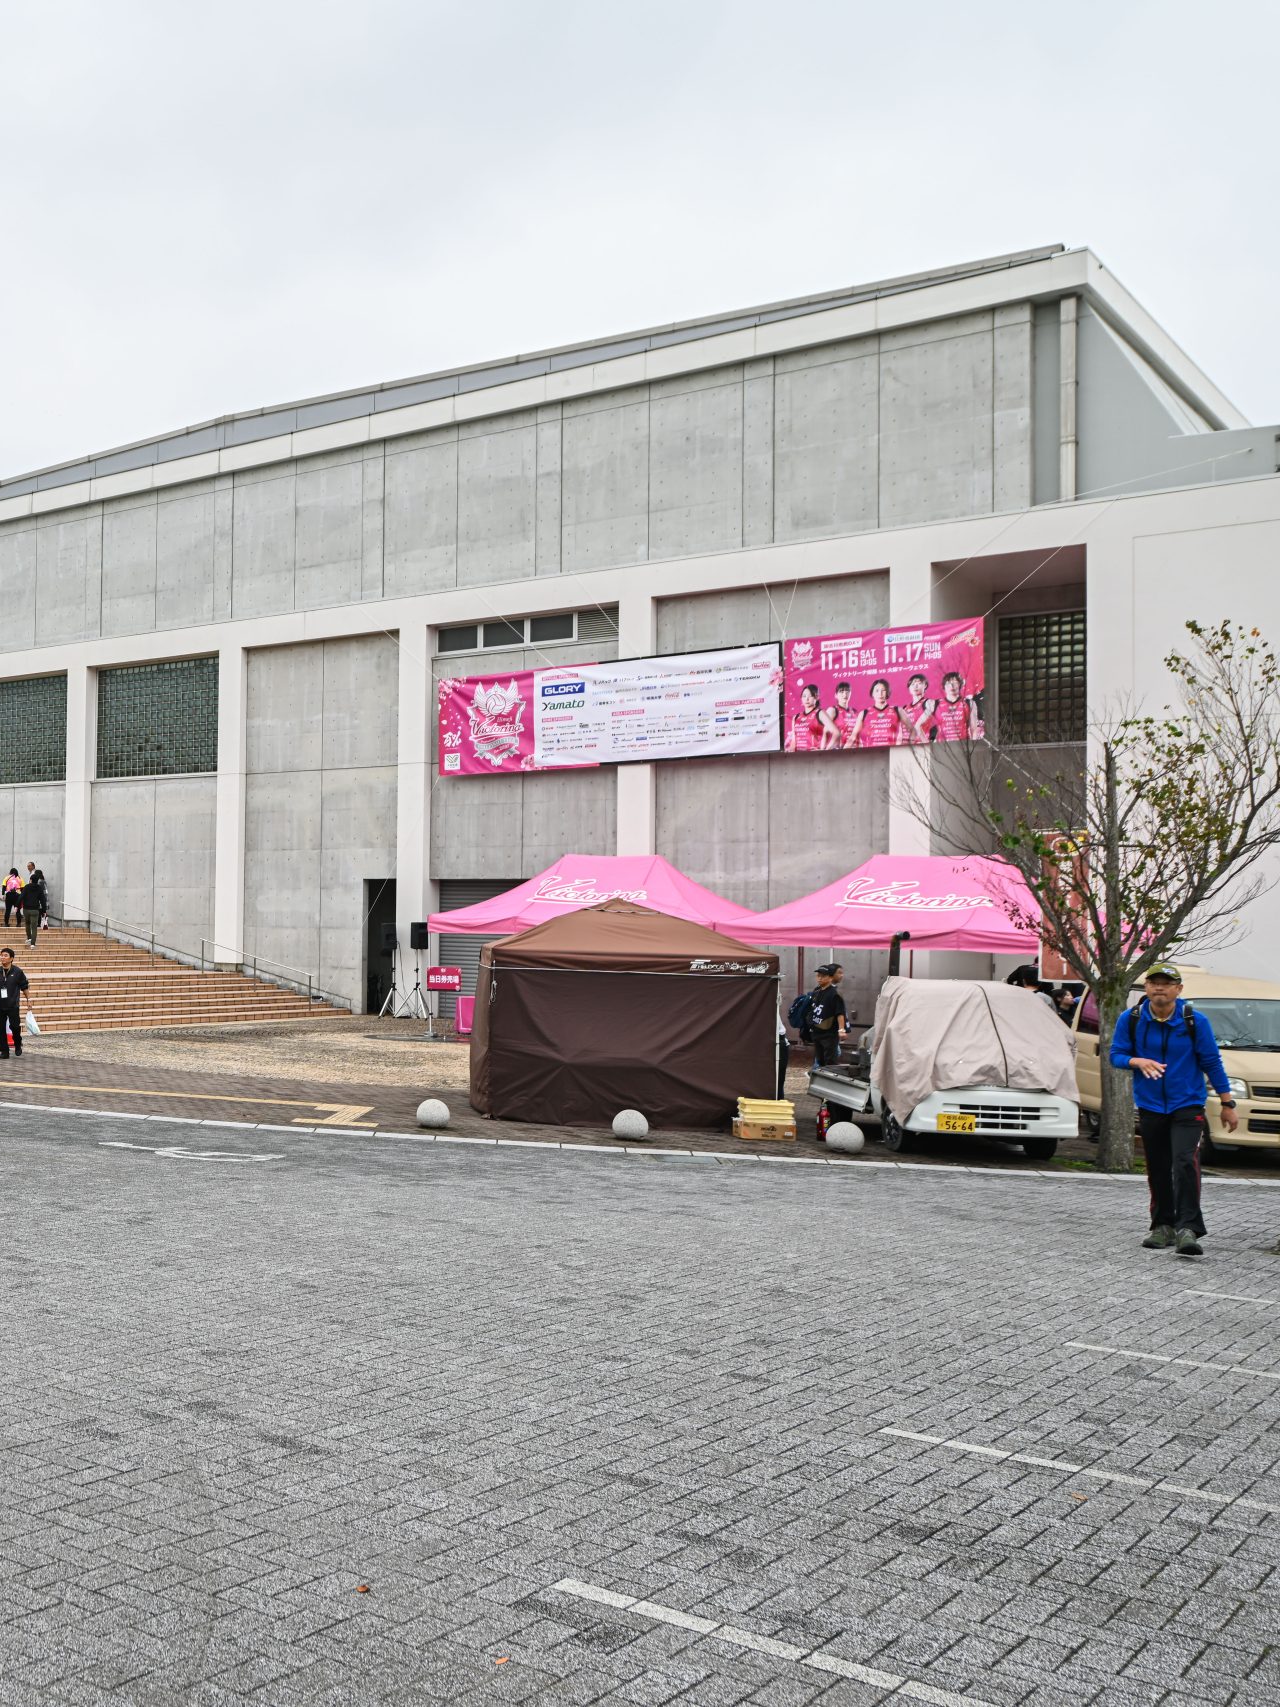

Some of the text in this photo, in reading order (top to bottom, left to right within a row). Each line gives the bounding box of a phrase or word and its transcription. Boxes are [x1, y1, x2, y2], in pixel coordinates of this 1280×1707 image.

[924, 642, 941, 651] SUN
[861, 649, 876, 658] SAT
[883, 643, 923, 664] 11.17
[924, 651, 942, 660] 14:05
[821, 650, 859, 670] 11.16
[861, 658, 877, 666] 13:05
[544, 684, 582, 695] GLORY
[542, 699, 585, 711] Yamato
[469, 716, 525, 741] Victorina
[527, 876, 647, 905] Victorina
[835, 877, 994, 912] Victorina
[429, 975, 460, 983] 当日券売場
[945, 1120, 973, 1131] 56-64
